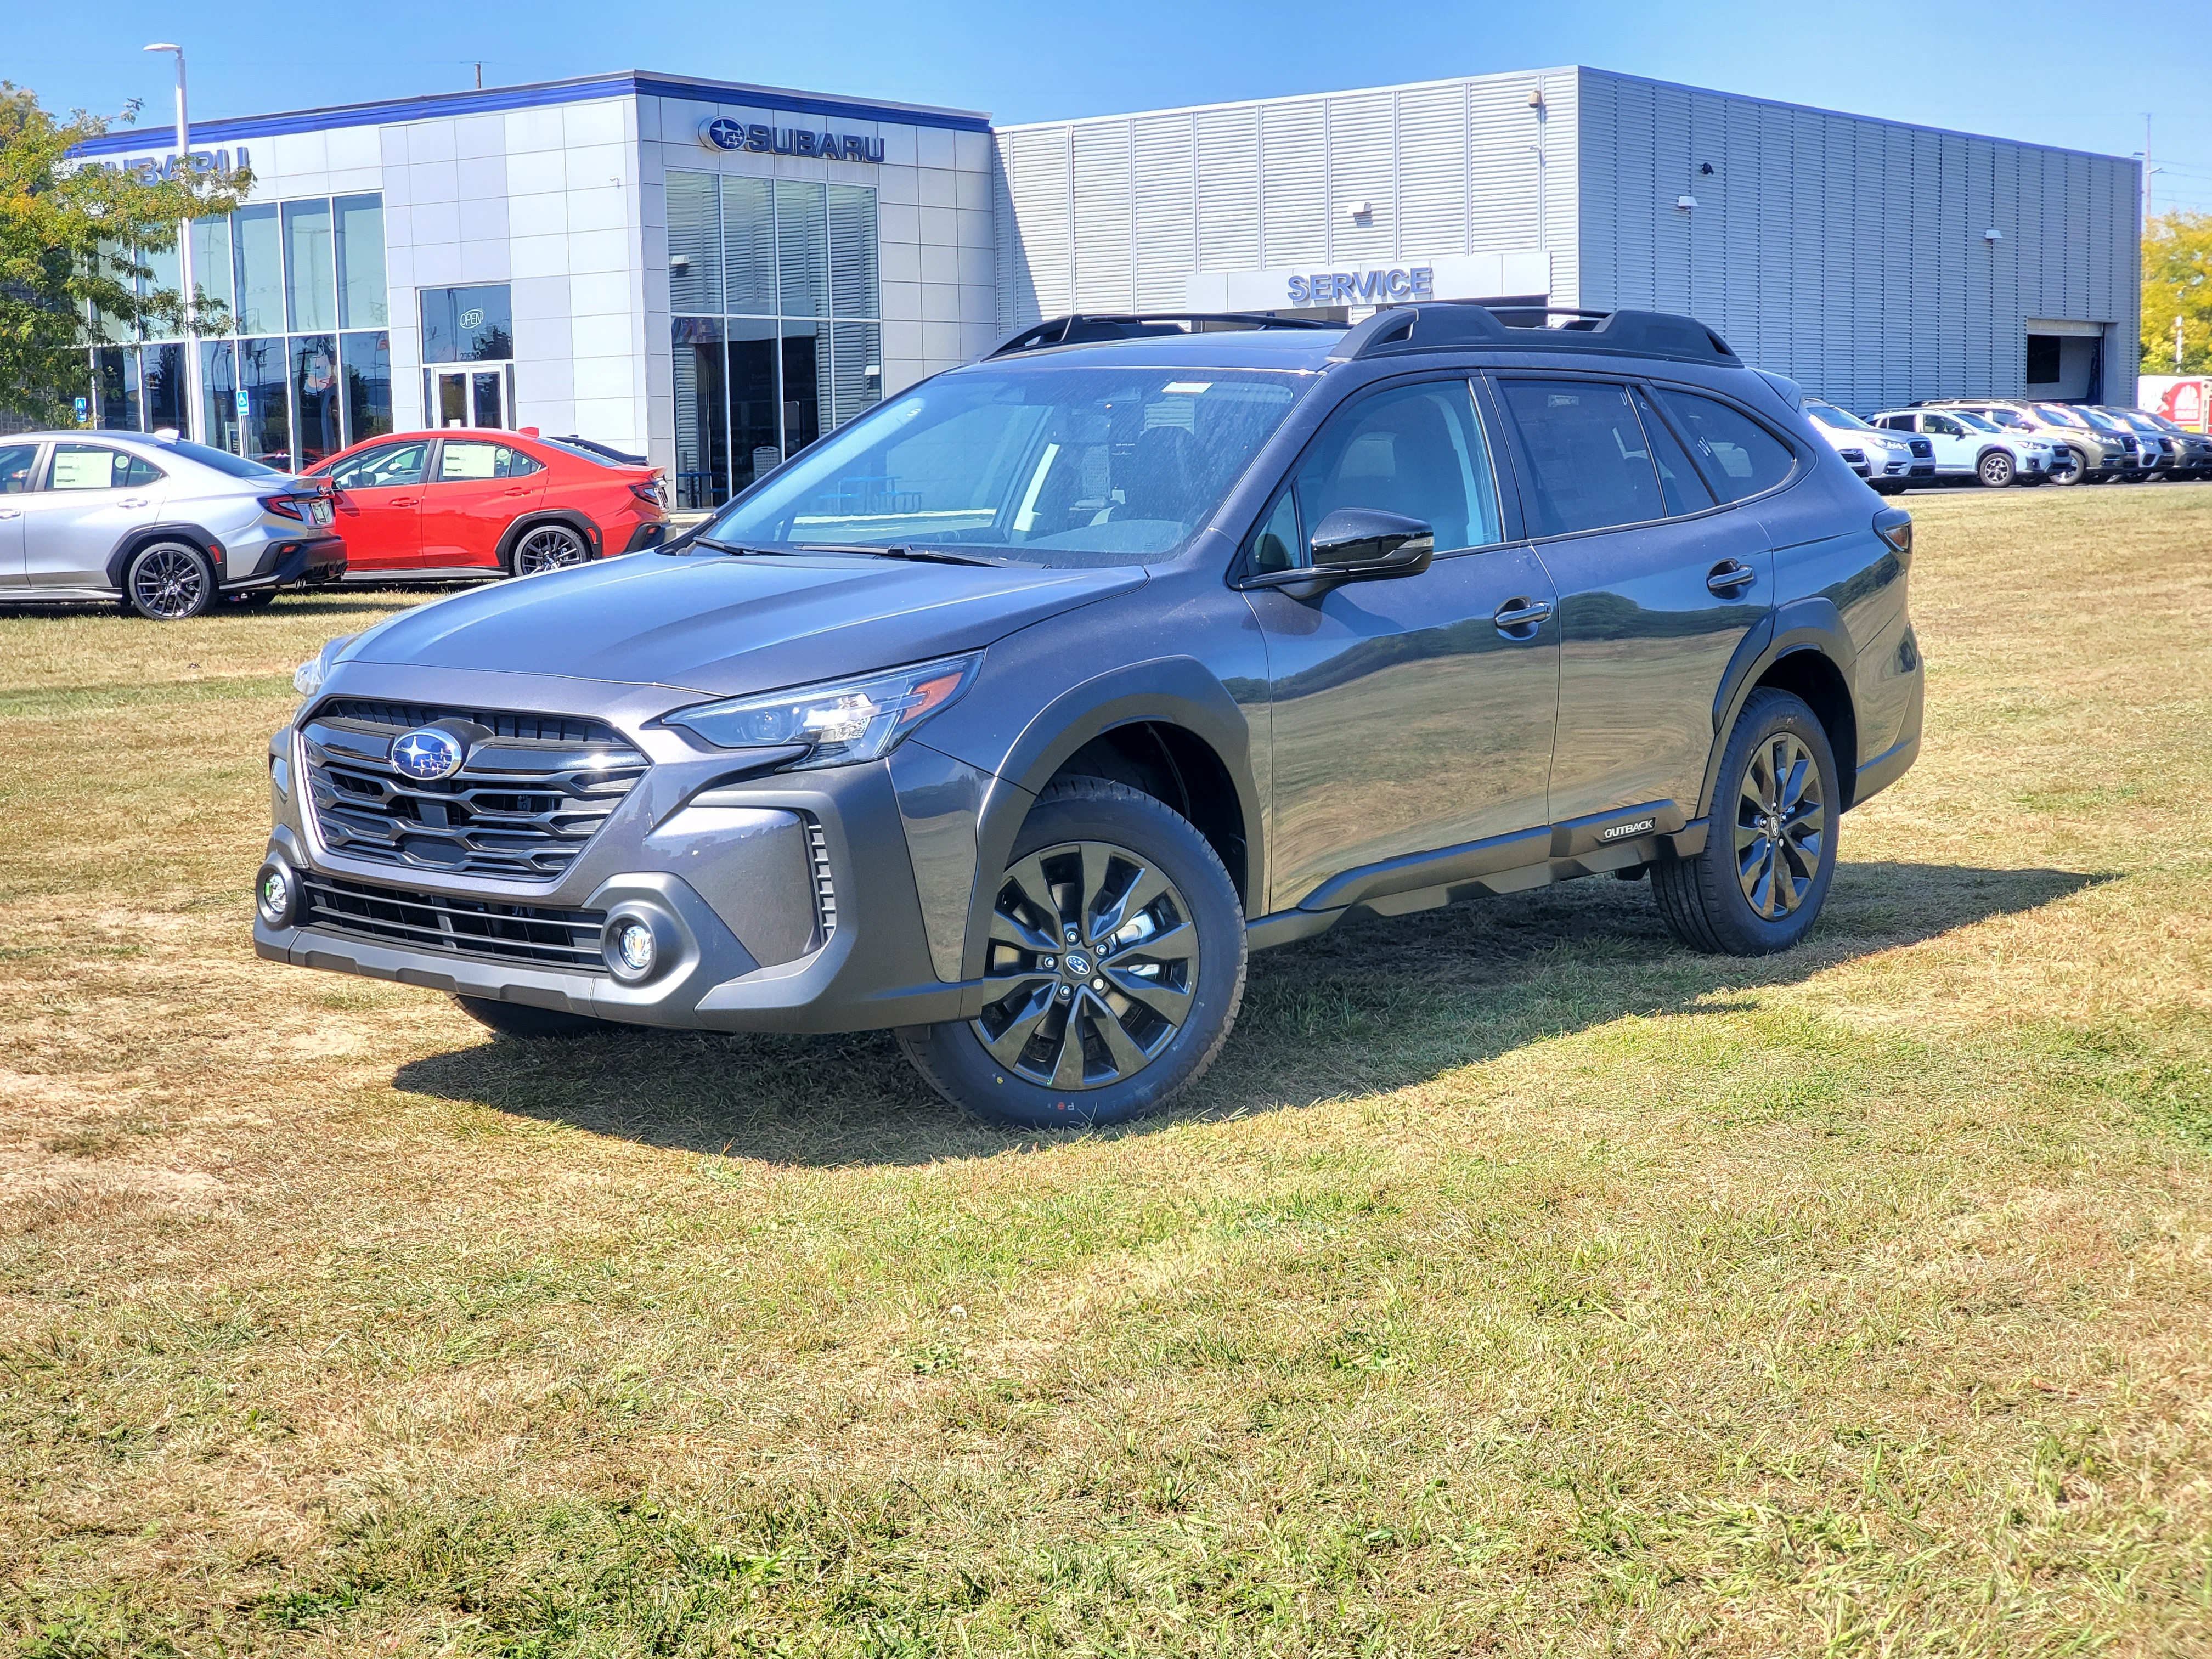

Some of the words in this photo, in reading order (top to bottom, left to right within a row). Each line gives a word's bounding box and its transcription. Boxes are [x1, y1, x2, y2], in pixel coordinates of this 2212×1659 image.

[747, 123, 885, 163] SUBARU
[80, 146, 251, 192] BARU
[1287, 267, 1433, 301] SERVICE
[460, 313, 482, 326] OPEN
[1604, 819, 1653, 838] OUTBACK
